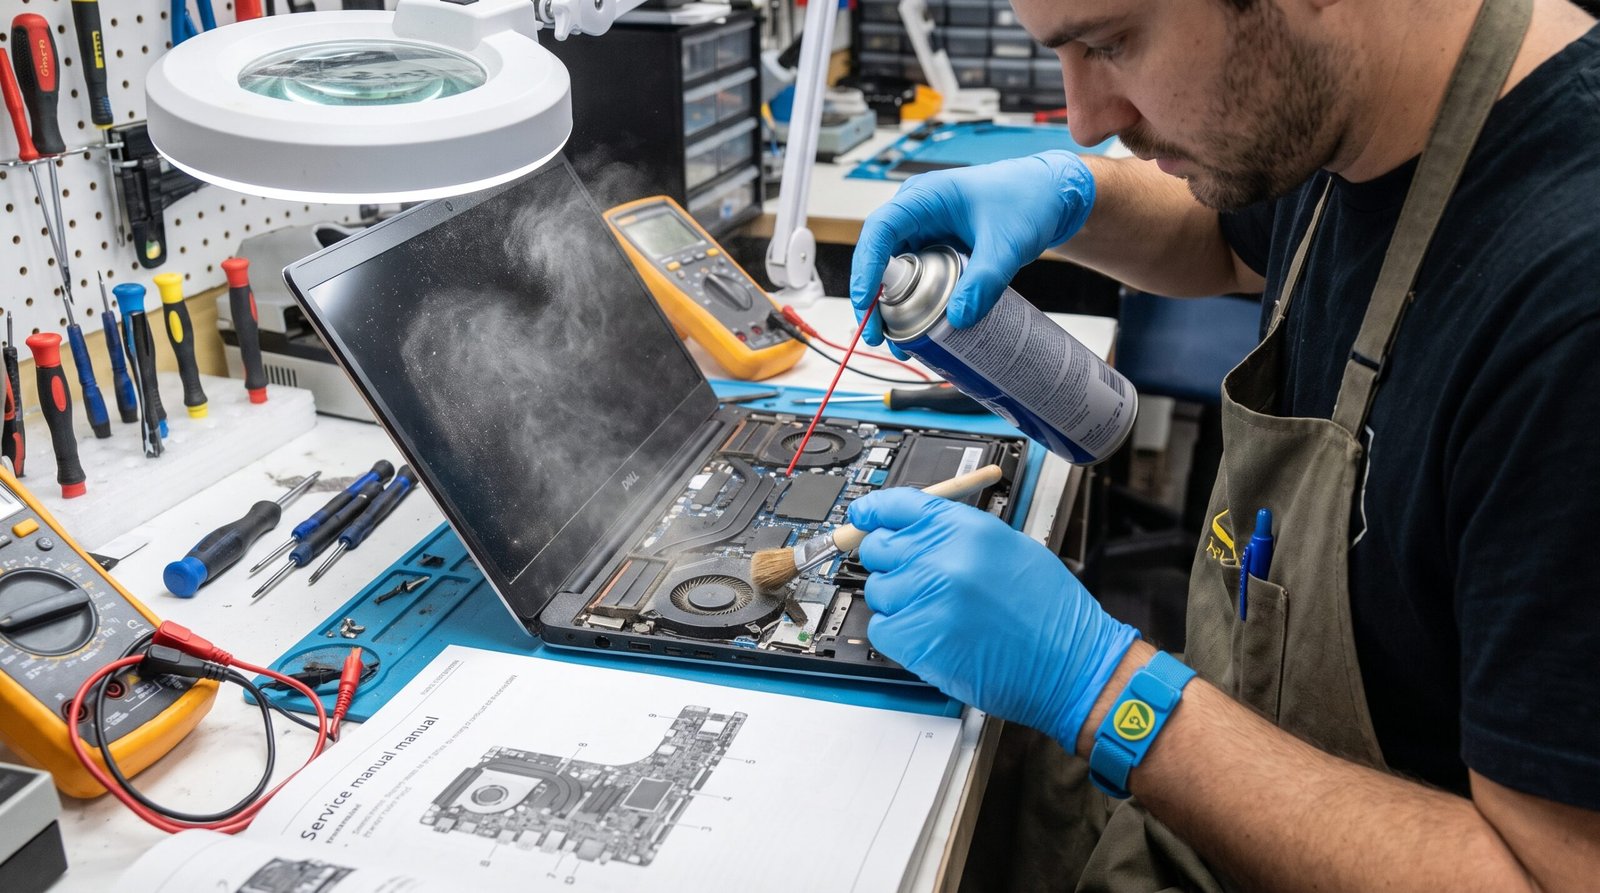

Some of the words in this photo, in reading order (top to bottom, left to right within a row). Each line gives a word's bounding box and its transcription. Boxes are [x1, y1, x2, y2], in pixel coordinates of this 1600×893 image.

[621, 471, 640, 491] DELL
[300, 790, 352, 842] Service
[350, 751, 397, 789] manual
[394, 715, 440, 751] manual
